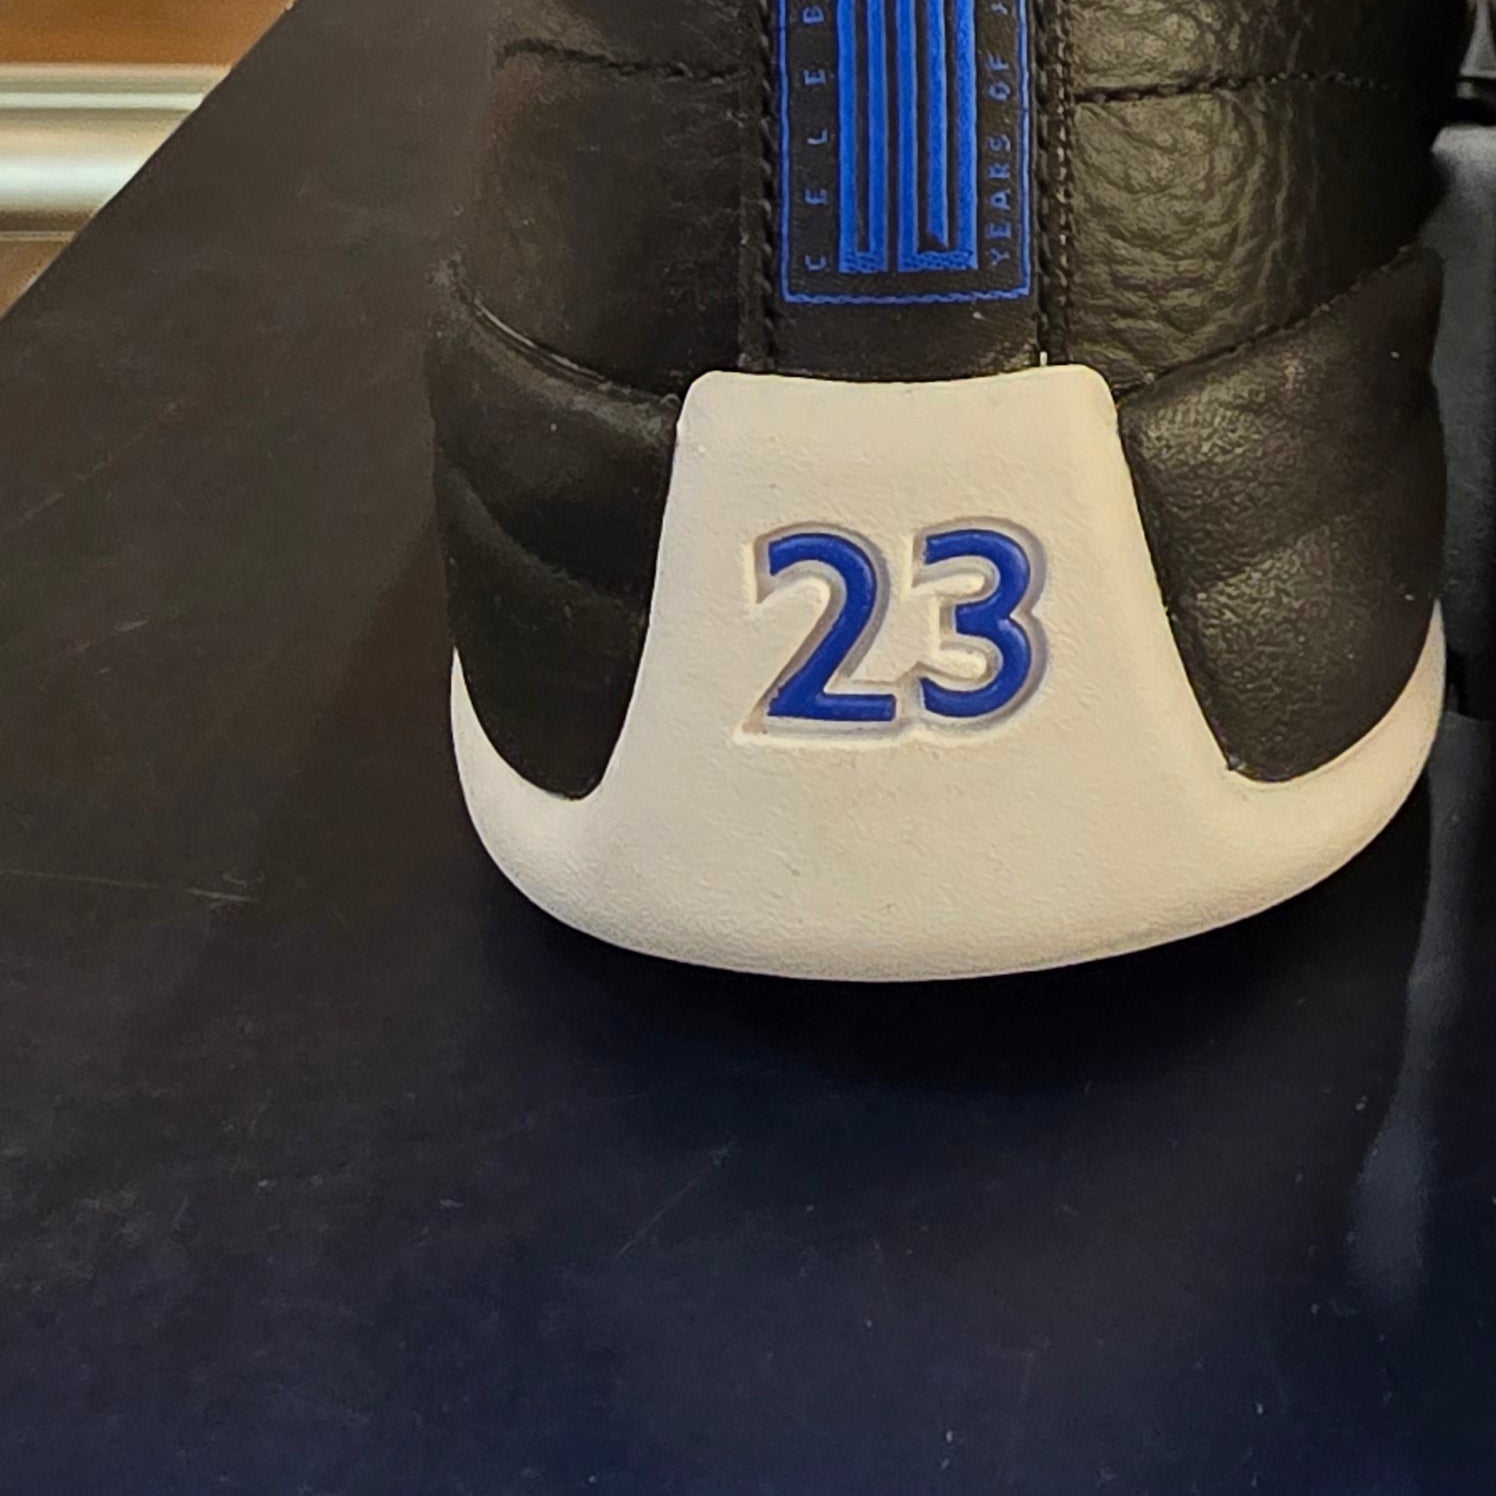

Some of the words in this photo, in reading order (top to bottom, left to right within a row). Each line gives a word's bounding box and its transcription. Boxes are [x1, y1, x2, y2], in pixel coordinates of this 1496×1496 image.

[986, 55, 1010, 101] OF
[985, 134, 1012, 265] YEARS
[745, 517, 1048, 738] 23
